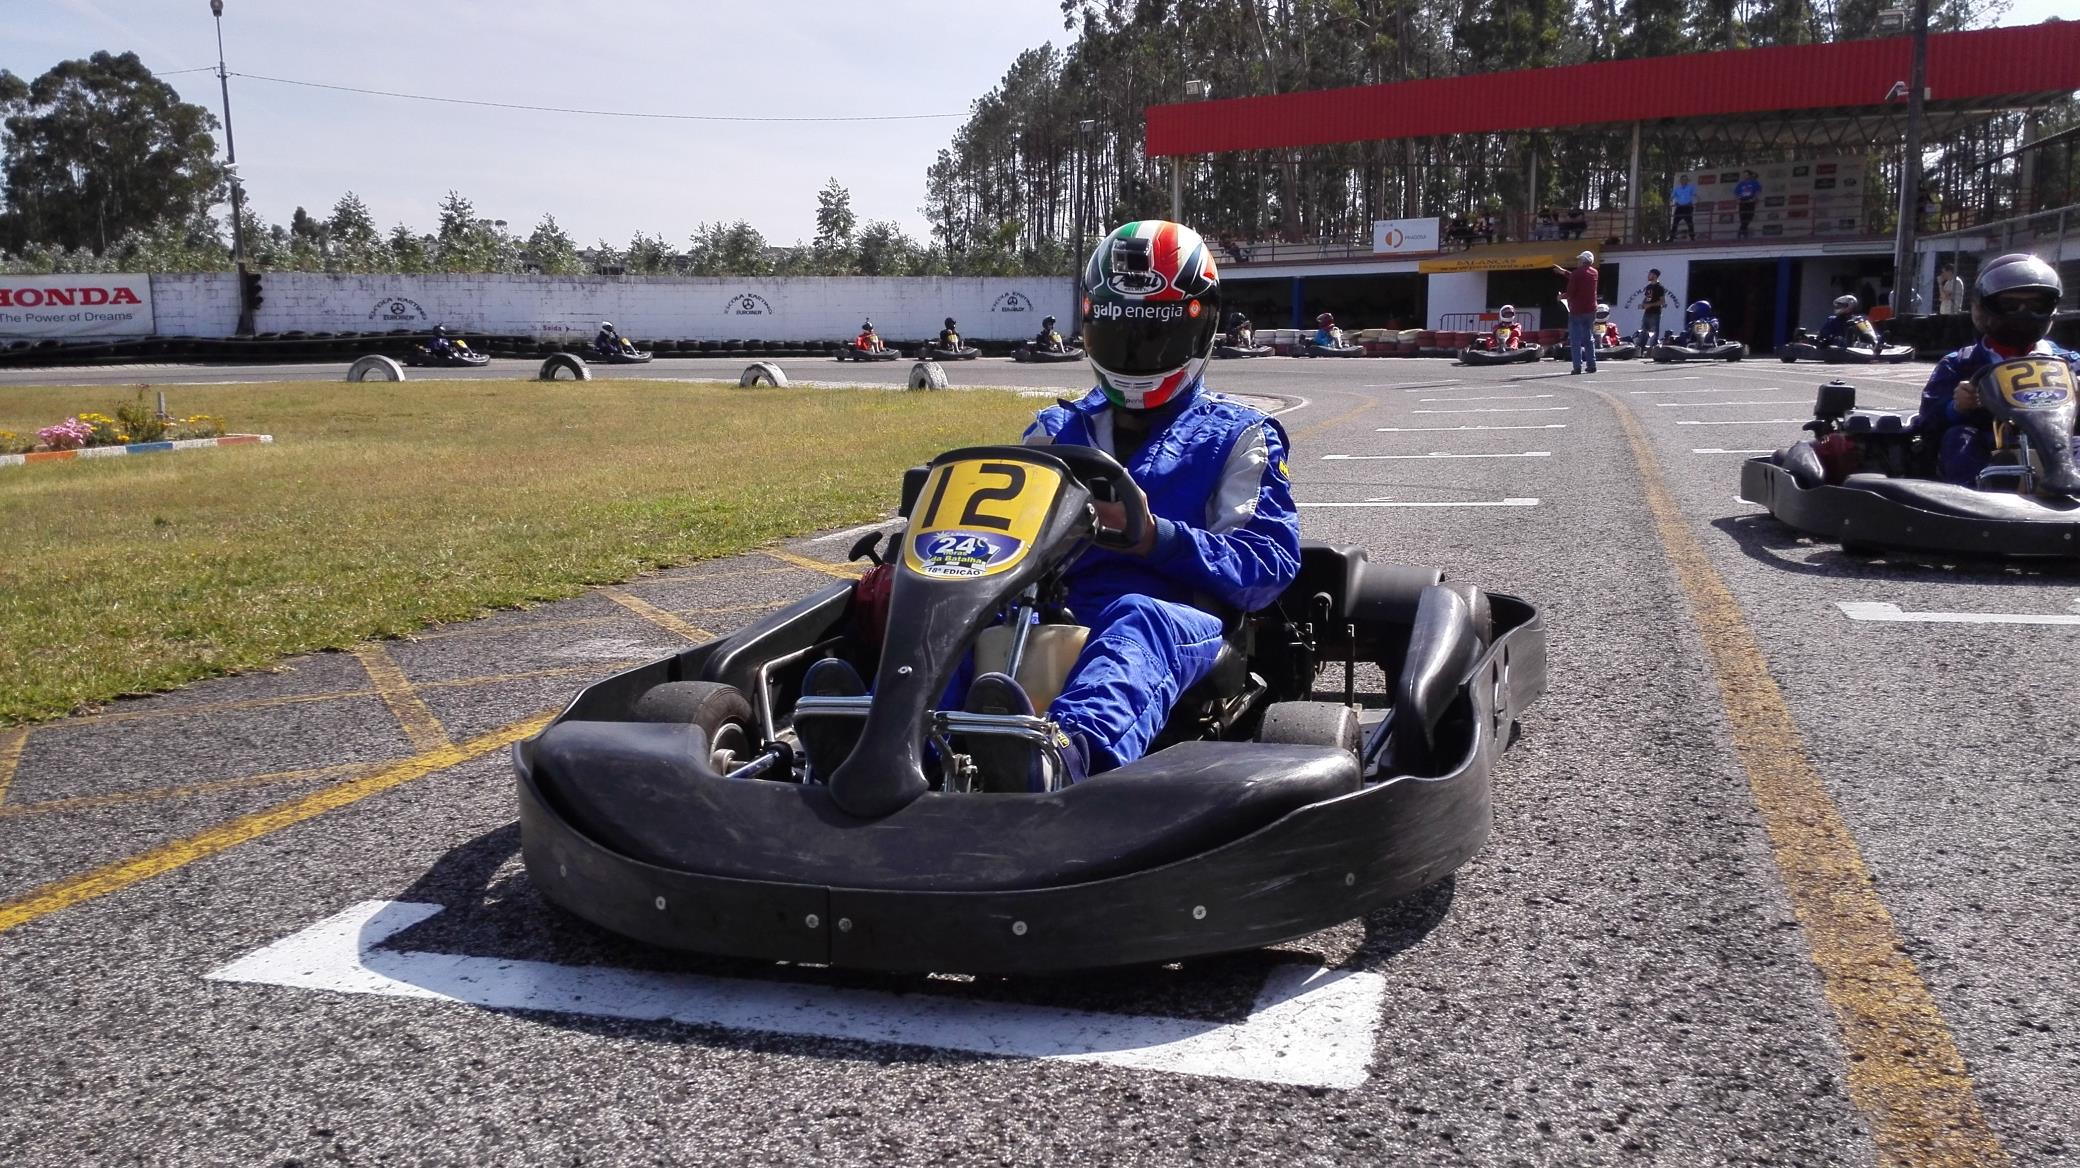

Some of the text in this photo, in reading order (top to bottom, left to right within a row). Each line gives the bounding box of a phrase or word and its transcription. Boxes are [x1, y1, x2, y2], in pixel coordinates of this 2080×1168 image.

[748, 293, 773, 315] KARTING
[1093, 302, 1183, 322] galp energia
[26, 313, 66, 322] Power
[69, 313, 80, 321] of
[85, 312, 133, 321] Dreams
[2006, 361, 2068, 391] 22
[921, 463, 1027, 531] 12
[935, 537, 976, 554] 24
[945, 555, 982, 564] Batalha
